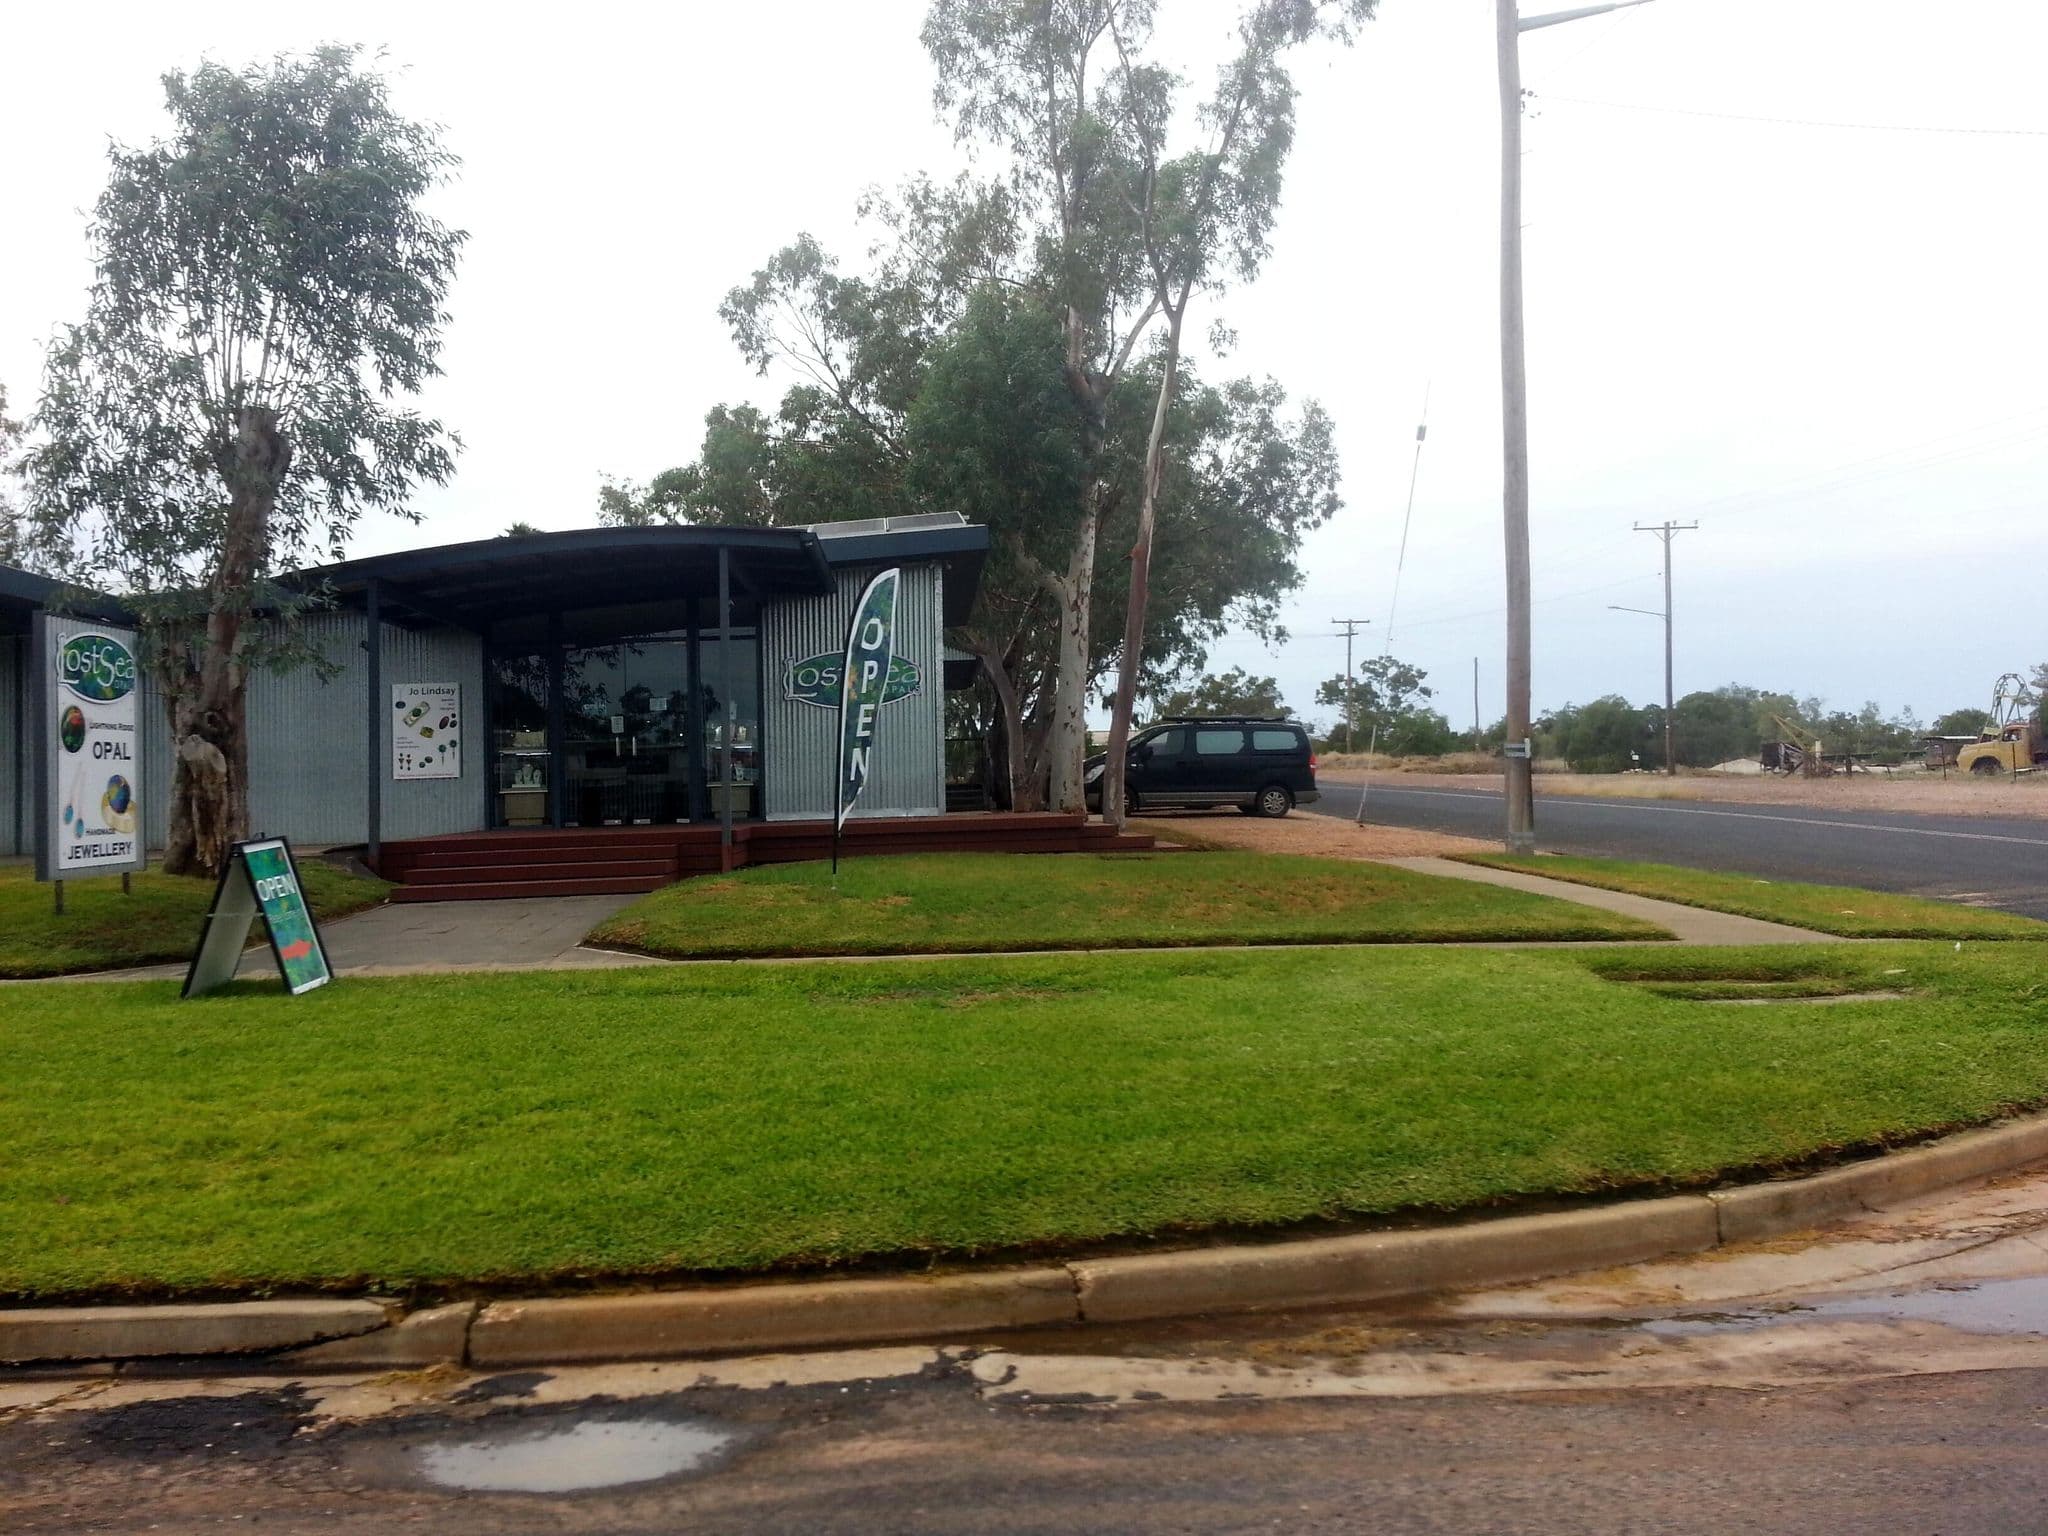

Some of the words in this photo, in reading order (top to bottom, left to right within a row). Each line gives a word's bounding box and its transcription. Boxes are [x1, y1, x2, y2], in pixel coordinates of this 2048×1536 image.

[787, 659, 842, 697] Los
[888, 664, 920, 684] ea
[409, 687, 420, 696] Jo
[422, 686, 456, 697] Lindsay
[850, 617, 883, 780] OPEN
[93, 741, 131, 760] OPAL
[68, 841, 132, 860] JEWELLERY
[256, 873, 296, 901] OPEN
